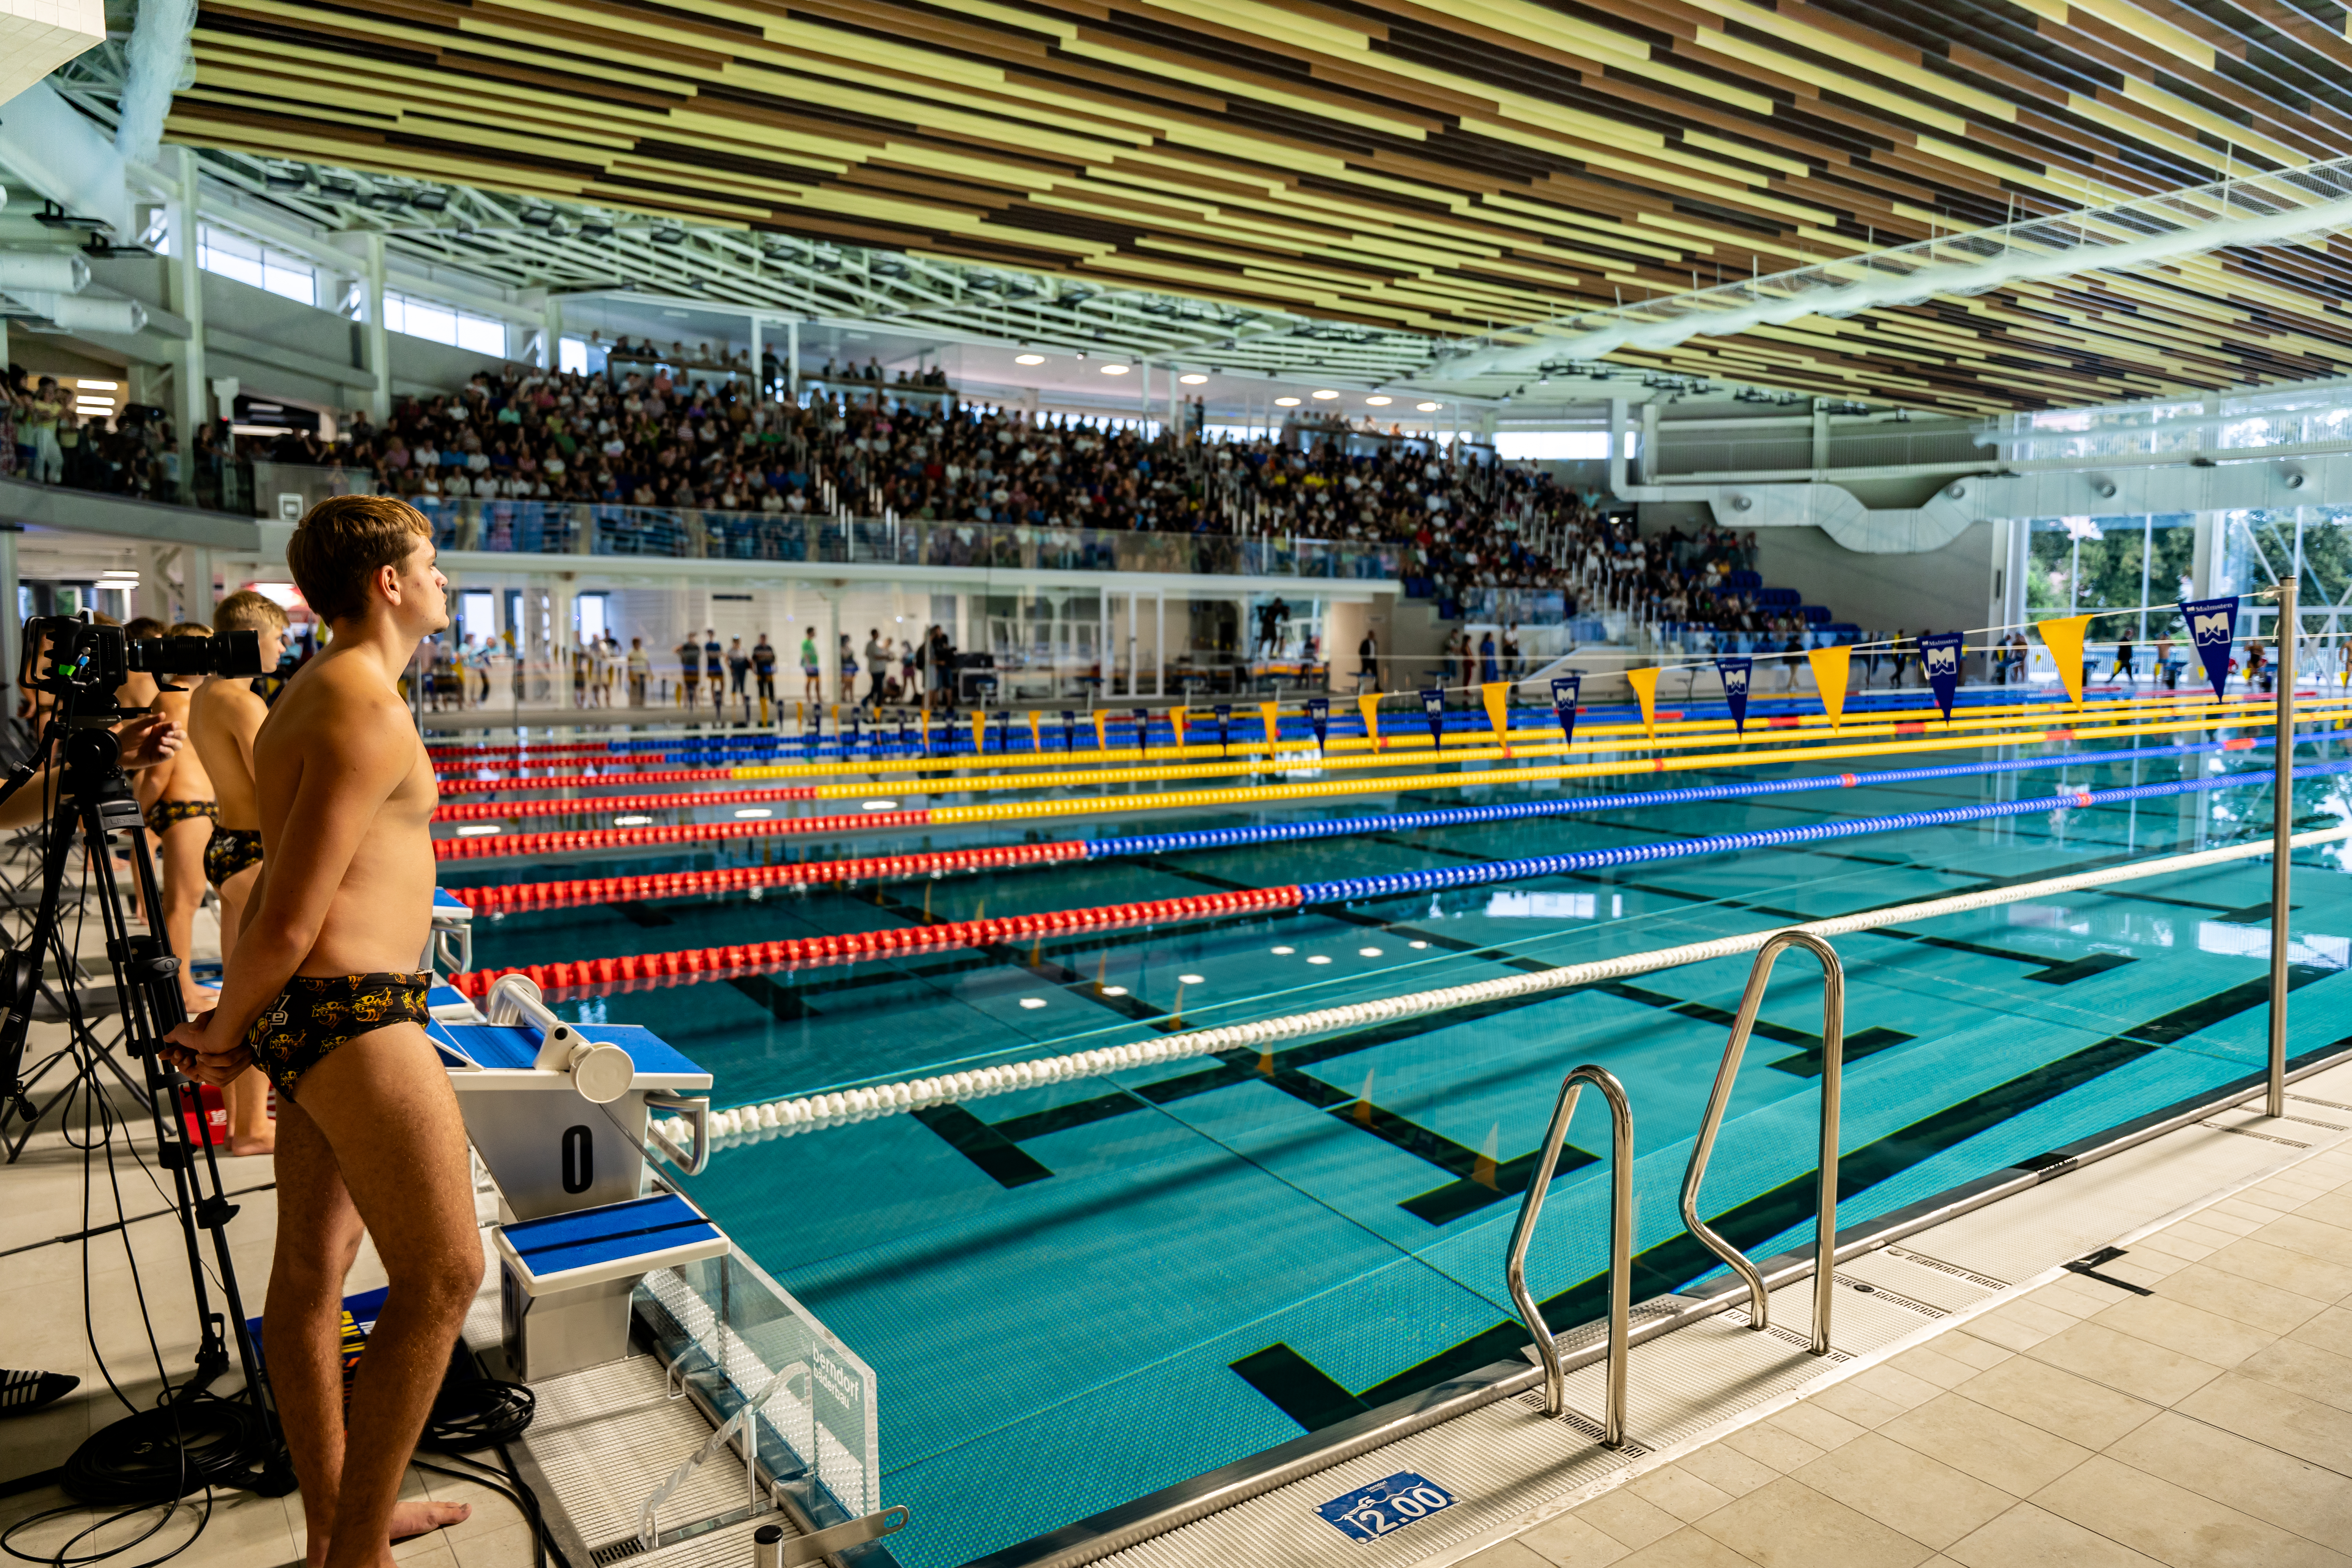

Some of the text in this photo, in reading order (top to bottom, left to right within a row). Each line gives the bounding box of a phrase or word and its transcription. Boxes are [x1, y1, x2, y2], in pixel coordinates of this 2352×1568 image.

[2196, 603, 2233, 612] Malmsten
[562, 1125, 593, 1194] 0
[813, 1341, 858, 1401] berndorf
[813, 1363, 849, 1409] bäderbau
[1366, 1480, 1388, 1490] berndorf
[1359, 1488, 1447, 1533] 2.00
